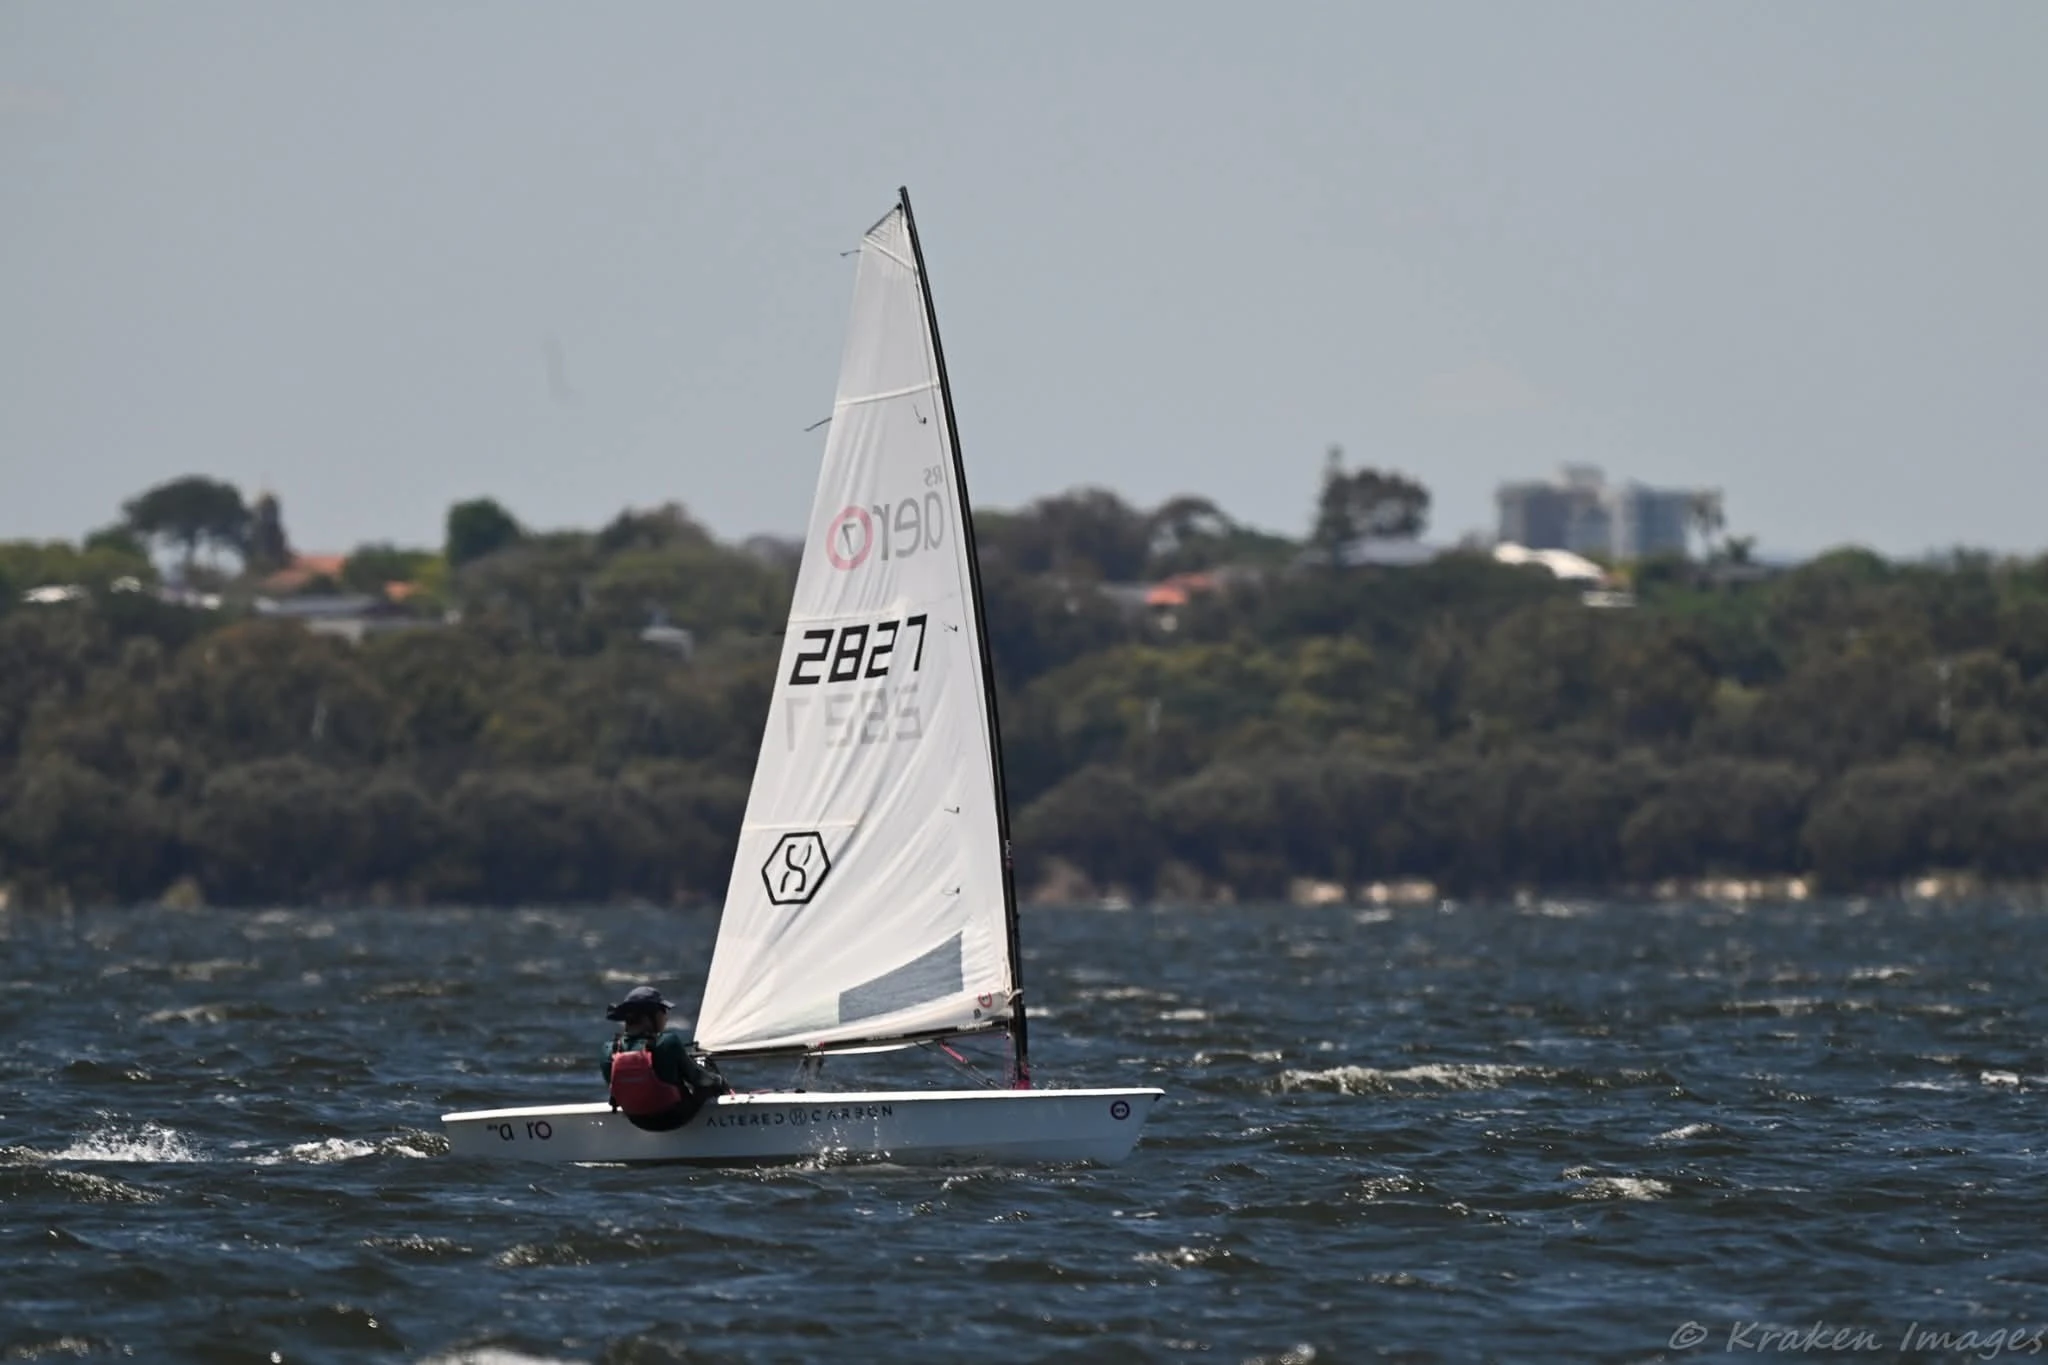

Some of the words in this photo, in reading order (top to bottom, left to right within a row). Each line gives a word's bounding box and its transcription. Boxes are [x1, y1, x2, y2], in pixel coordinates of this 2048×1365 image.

[788, 613, 928, 686] 2827
[706, 1111, 785, 1128] ALTERED
[811, 1104, 893, 1122] CARBON
